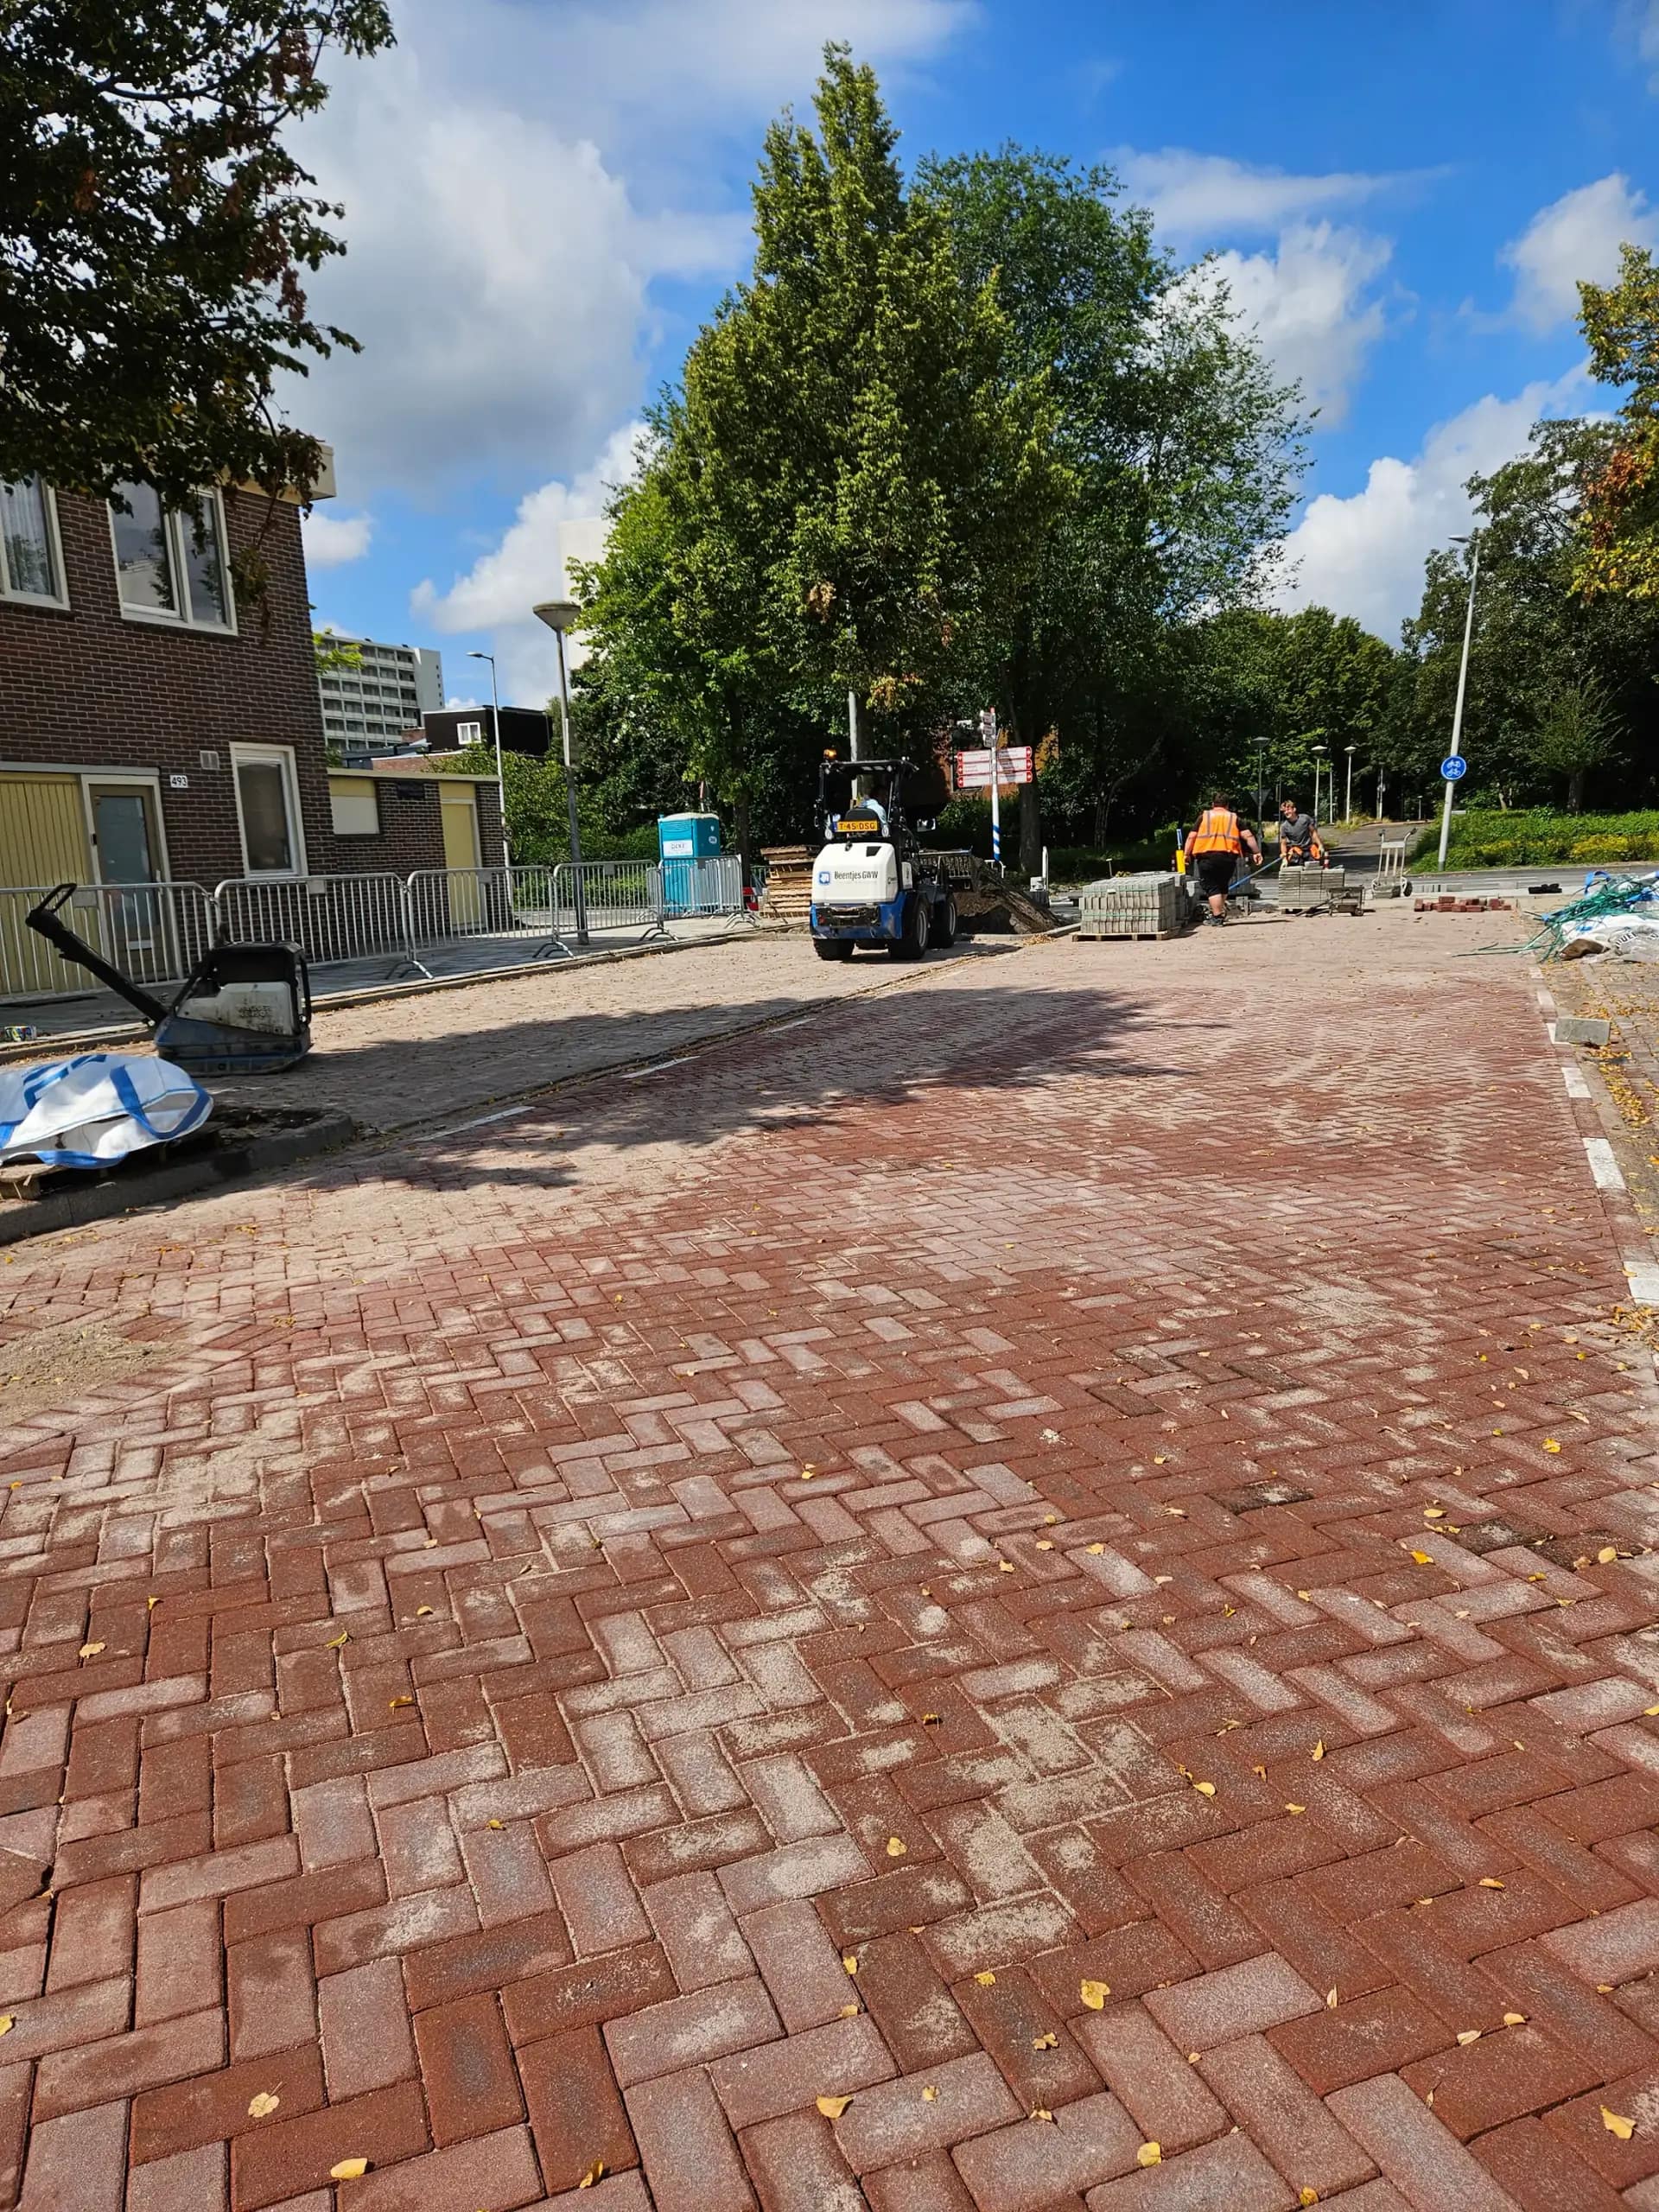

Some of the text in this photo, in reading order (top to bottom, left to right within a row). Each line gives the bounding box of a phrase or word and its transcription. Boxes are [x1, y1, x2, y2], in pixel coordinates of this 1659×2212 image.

[172, 777, 187, 786] 493
[834, 870, 879, 881] Beentjes GWW
